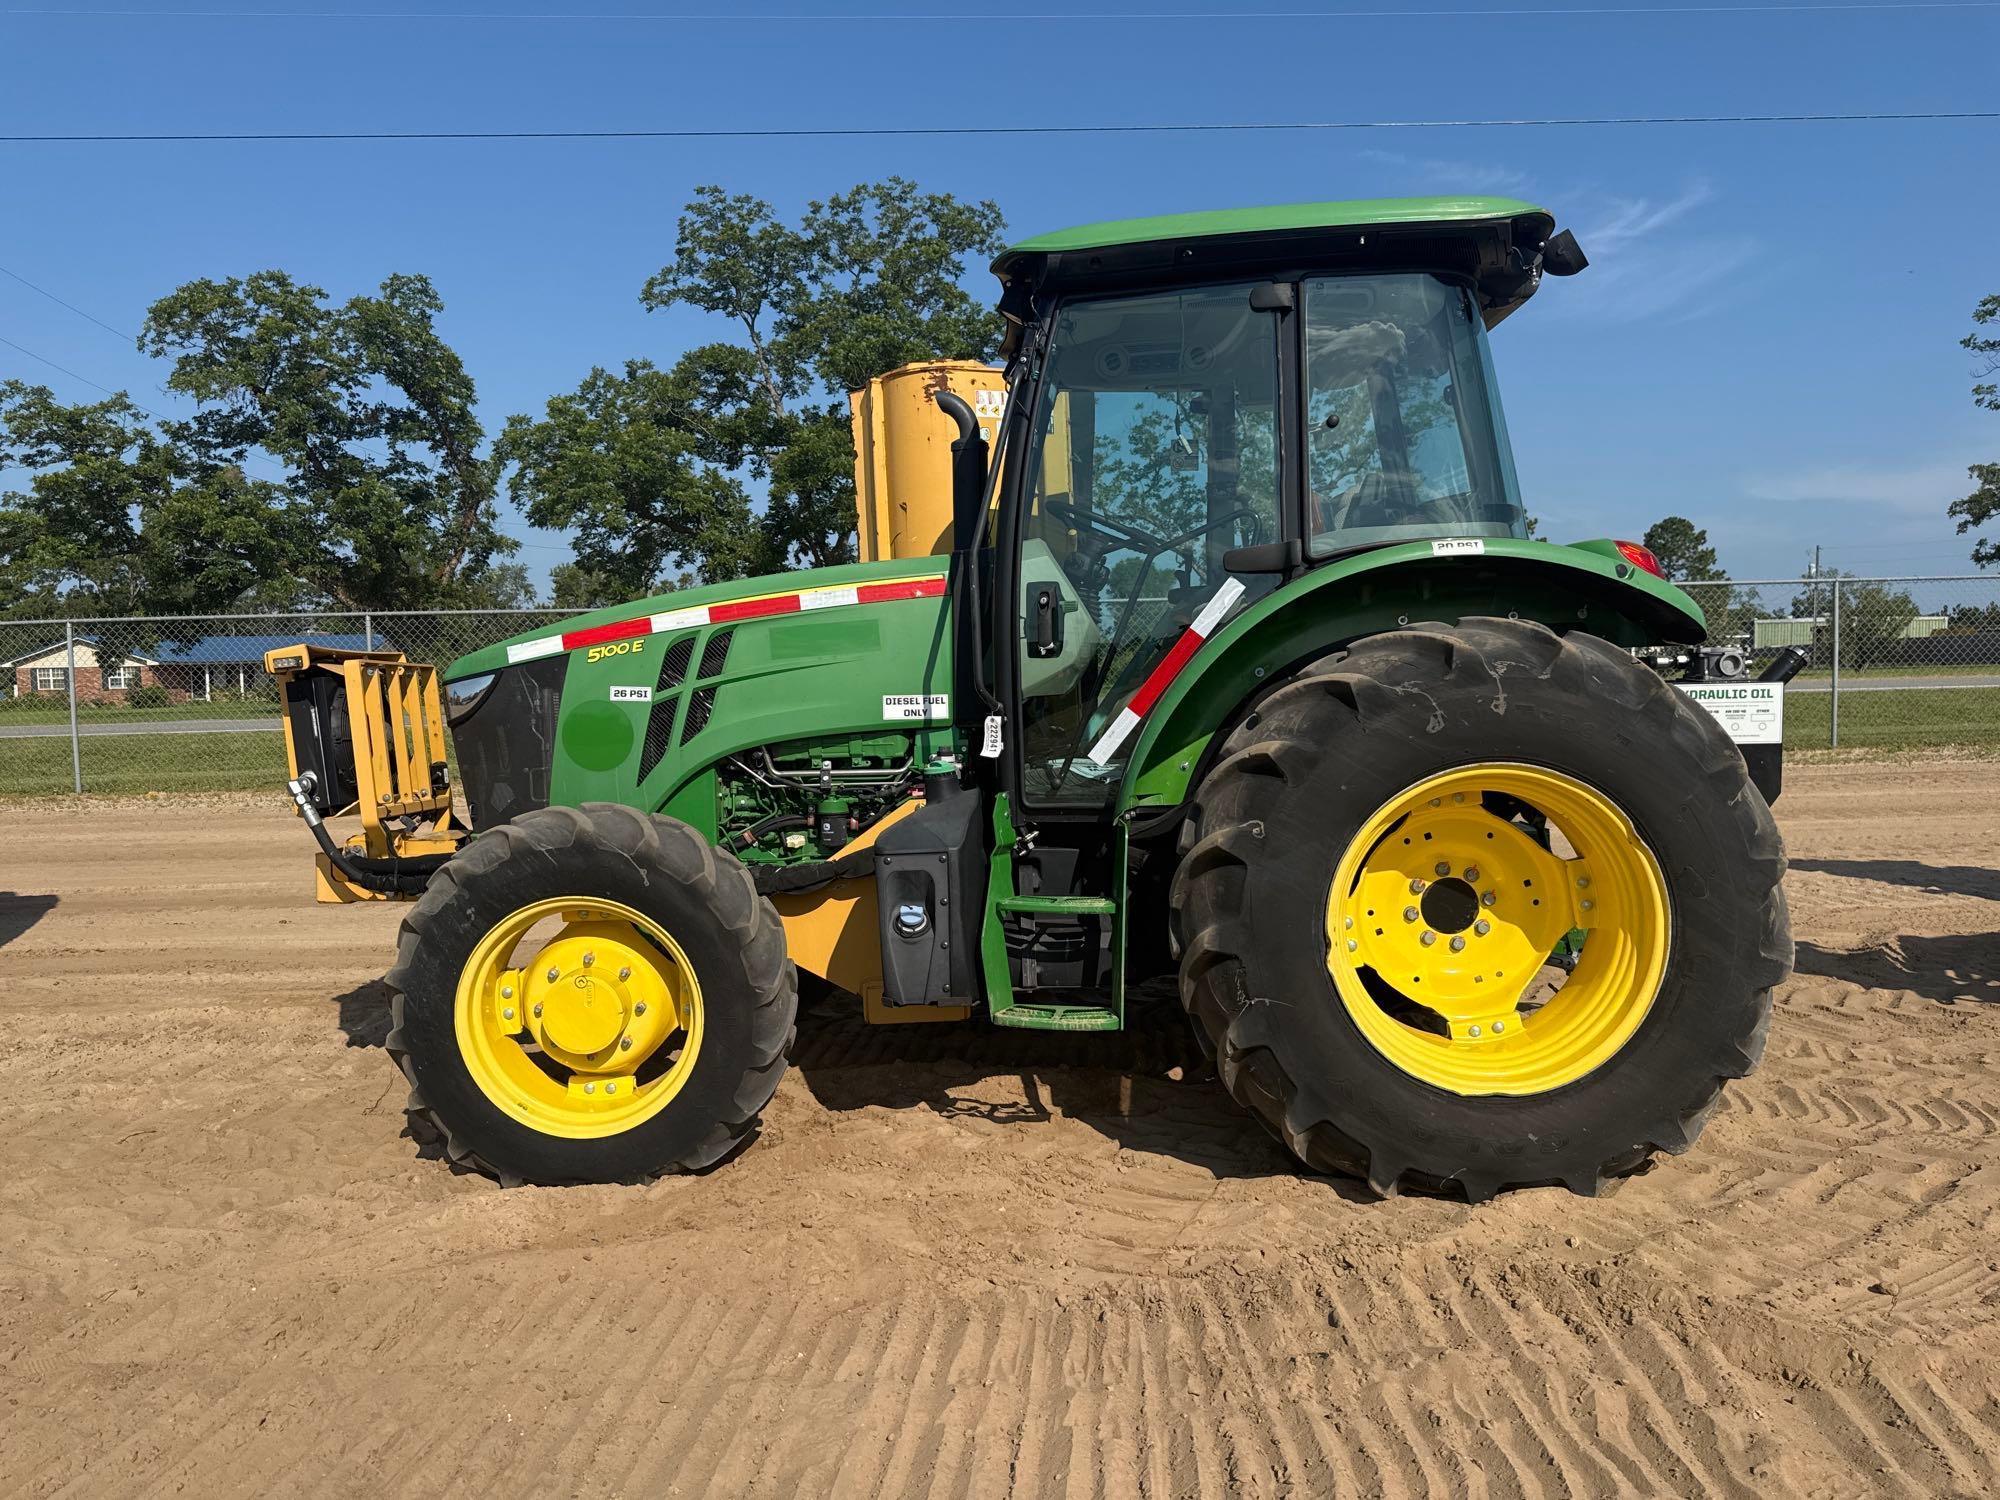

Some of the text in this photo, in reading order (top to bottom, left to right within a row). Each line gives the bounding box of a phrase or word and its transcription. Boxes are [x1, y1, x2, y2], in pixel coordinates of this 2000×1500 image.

[587, 639, 645, 663] 5100 E
[613, 689, 648, 698] 26 PSI
[1751, 688, 1774, 699] OIL
[885, 697, 946, 706] DIESEL FUEL
[903, 709, 928, 717] ONLY
[989, 724, 999, 752] 222941
